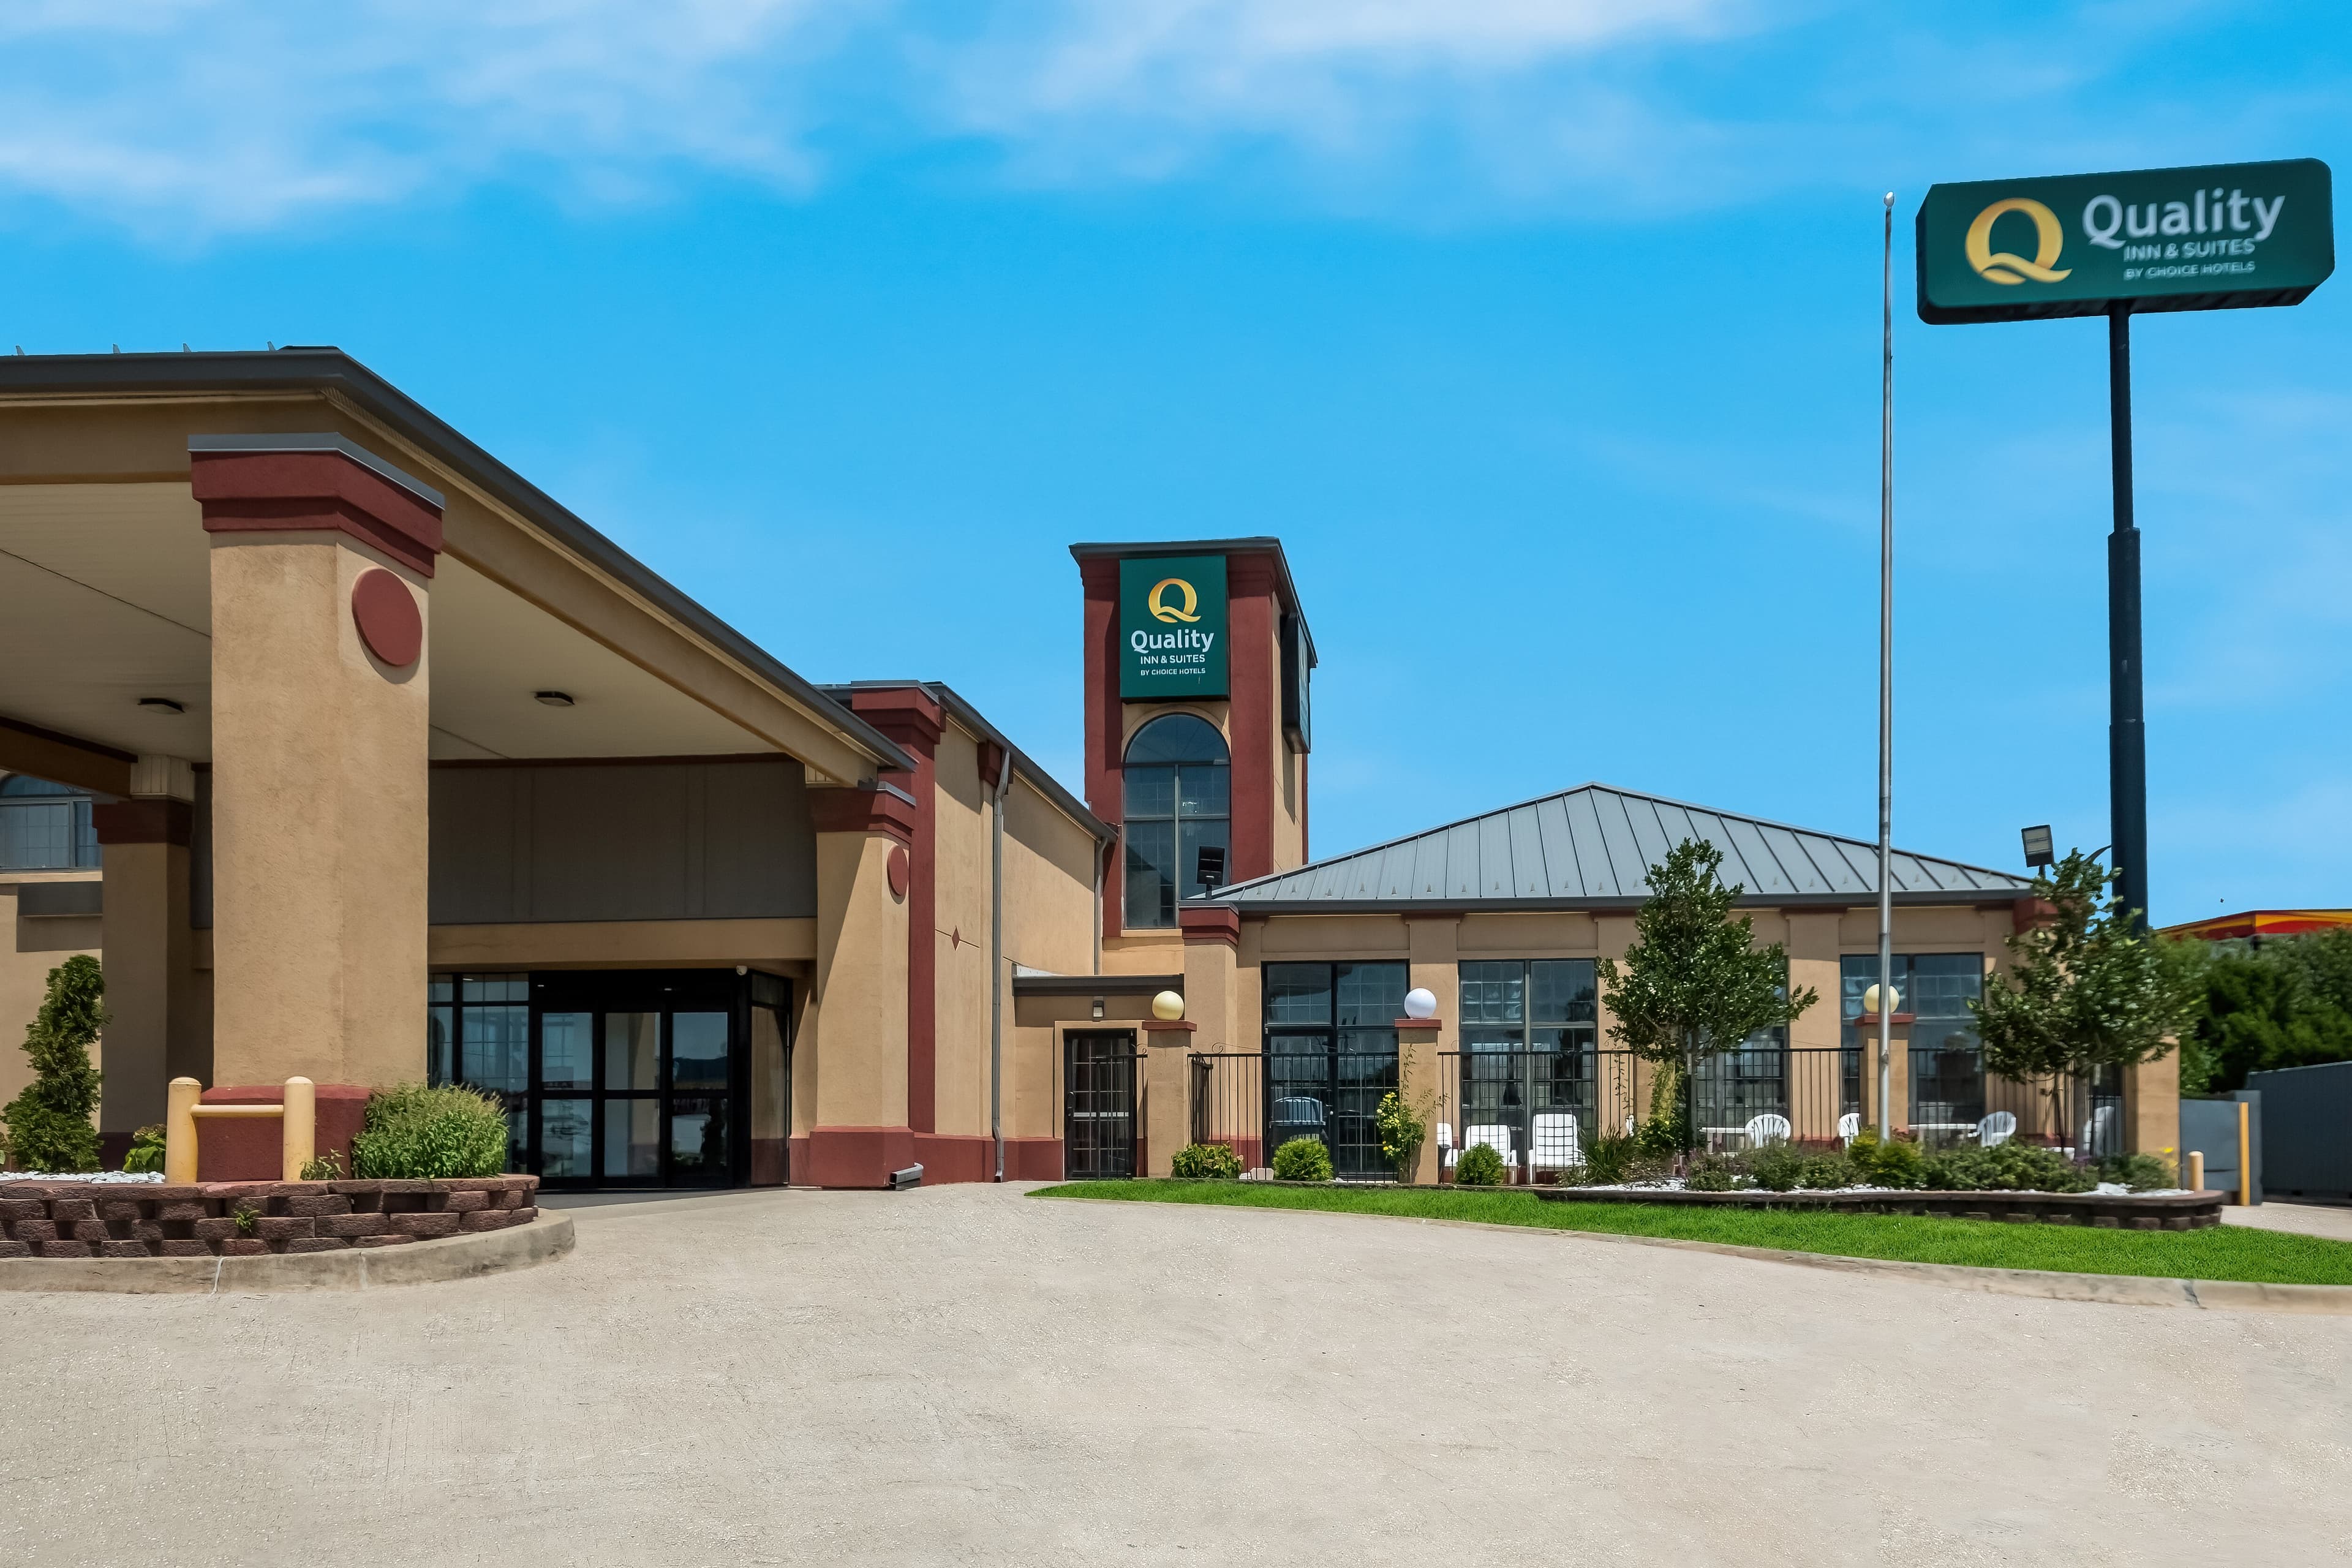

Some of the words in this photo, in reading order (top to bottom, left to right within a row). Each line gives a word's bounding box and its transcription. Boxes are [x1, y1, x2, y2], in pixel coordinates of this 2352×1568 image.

[2082, 187, 2286, 249] Quality
[1966, 197, 2072, 285] Q
[2124, 244, 2161, 262] INN
[2163, 243, 2179, 260] &
[2182, 238, 2256, 258] SUITES
[2124, 268, 2143, 280] BY
[2145, 265, 2199, 278] CHOICE
[2201, 260, 2256, 274] HOTELS
[1148, 578, 1201, 623] Q
[1131, 629, 1214, 654] Quality
[1140, 656, 1159, 665] INN
[1169, 654, 1205, 663] SUITES
